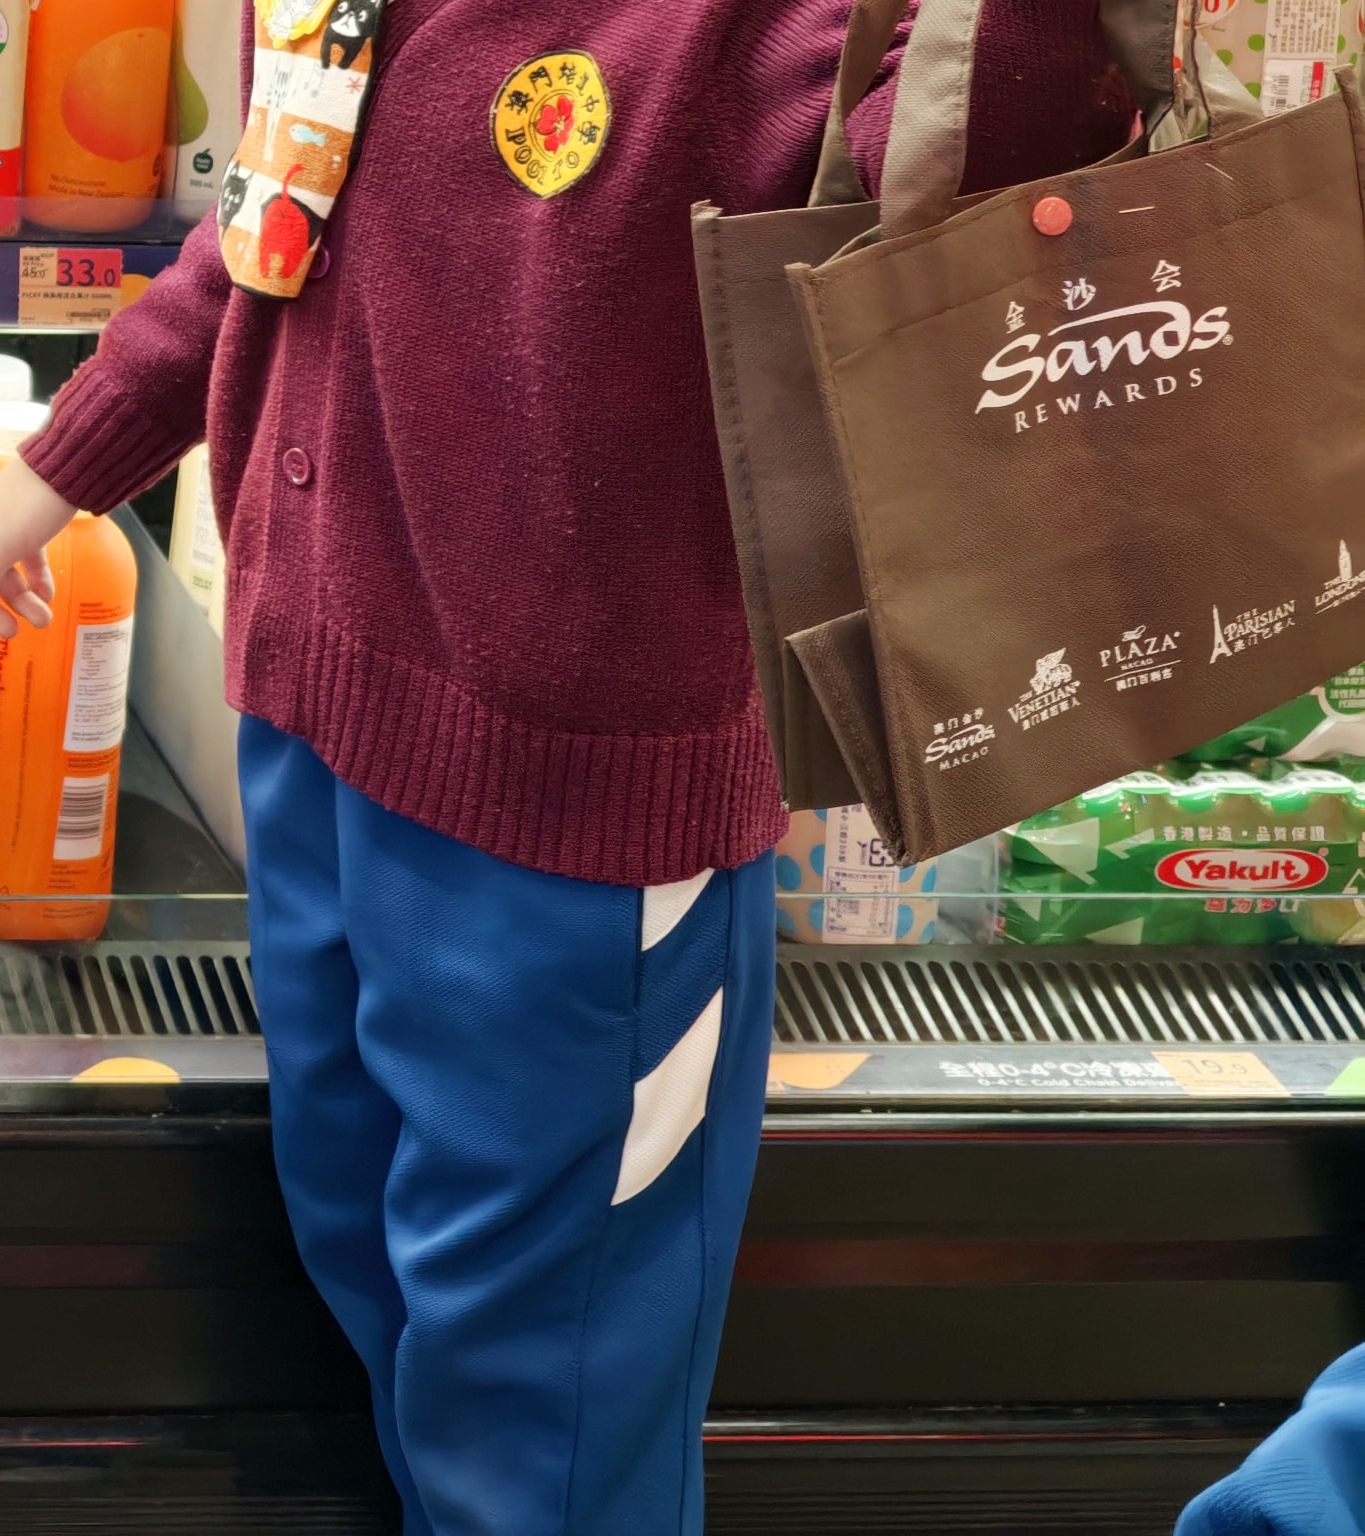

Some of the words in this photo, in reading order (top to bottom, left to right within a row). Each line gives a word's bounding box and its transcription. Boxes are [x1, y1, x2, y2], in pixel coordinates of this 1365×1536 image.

[57, 258, 117, 288] 33.0
[975, 299, 1229, 416] Sands
[1014, 367, 1204, 433] REWARDS
[1224, 600, 1296, 642] PARISIAN
[1099, 633, 1178, 668] PLAZA
[1007, 682, 1077, 724] VENETIAN
[924, 724, 996, 764] Sands
[939, 746, 990, 772] MACAO
[1186, 857, 1302, 884] Yakult
